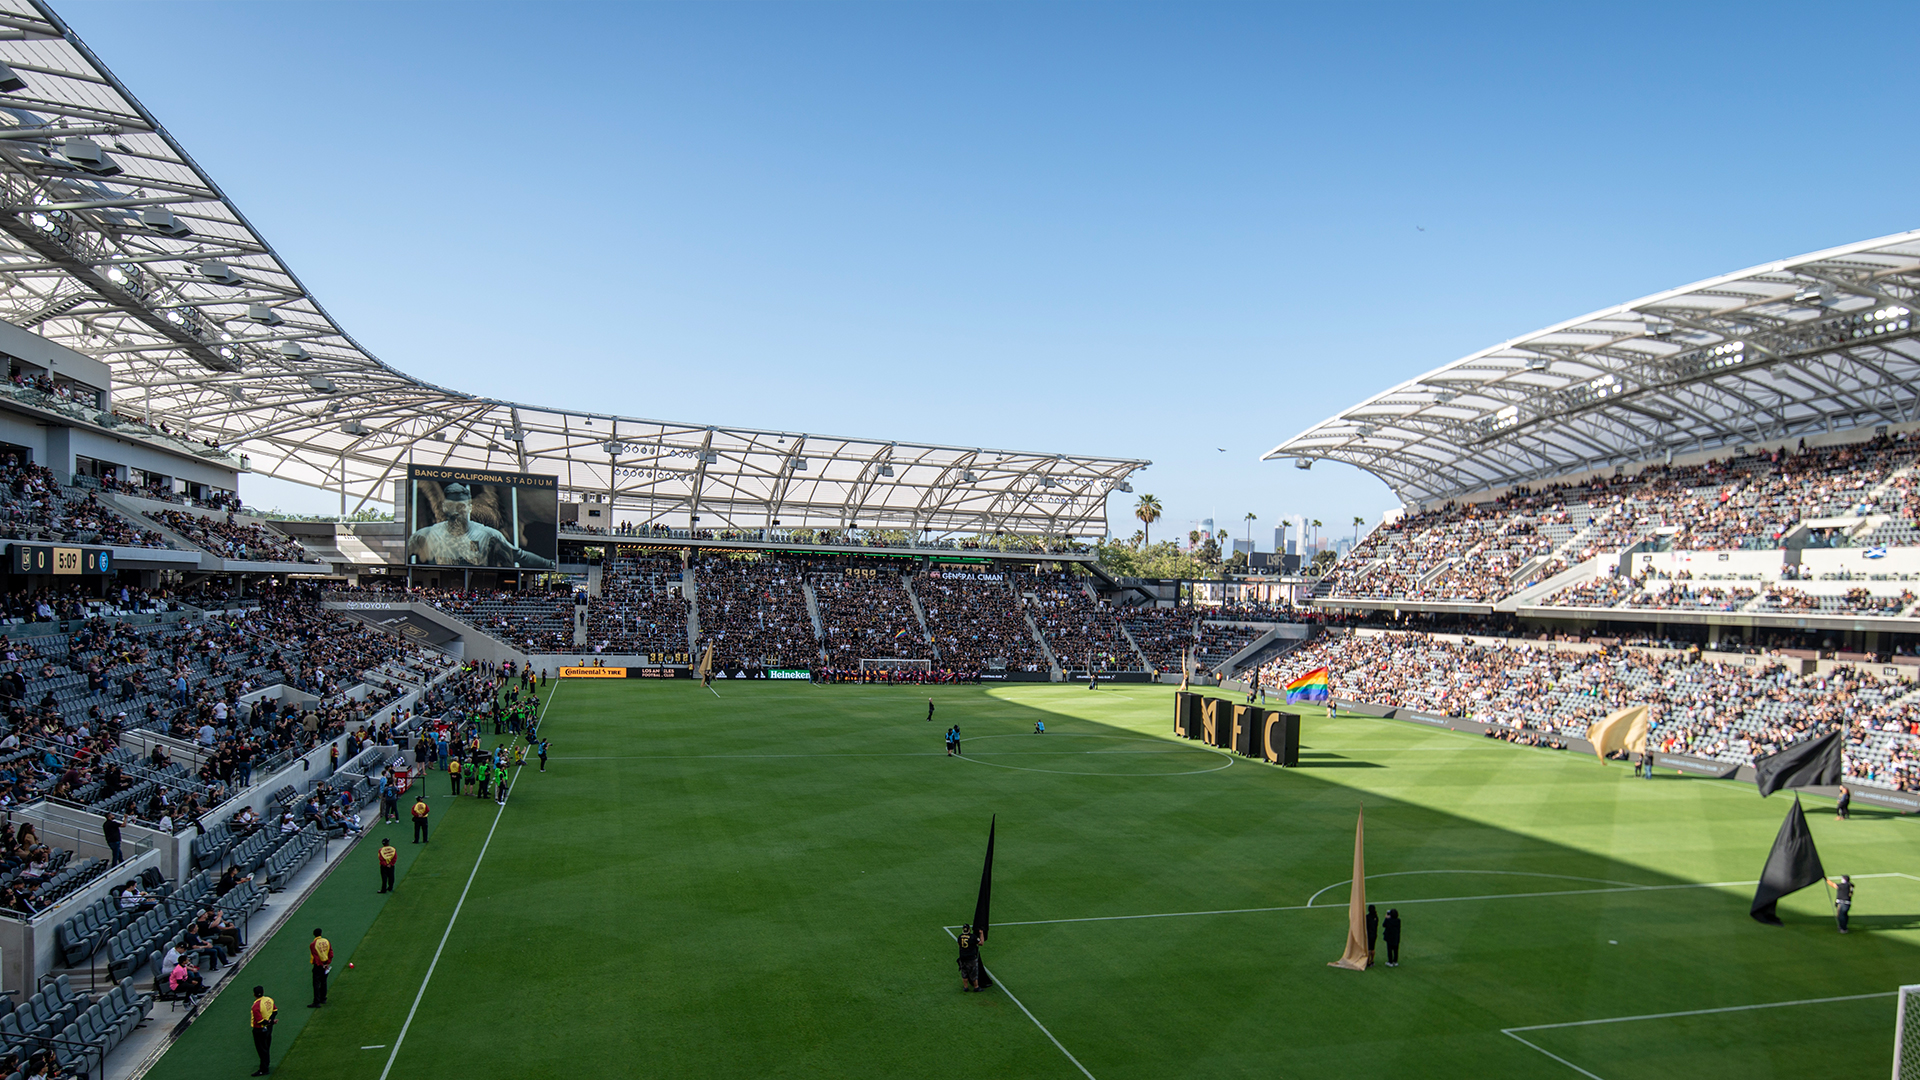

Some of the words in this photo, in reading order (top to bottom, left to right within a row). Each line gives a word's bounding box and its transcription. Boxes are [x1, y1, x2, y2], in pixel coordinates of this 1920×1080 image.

[415, 469, 439, 478] BANC
[441, 471, 452, 479] OF
[454, 472, 503, 483] CALIFORNIA
[505, 476, 553, 487] STADIUM
[38, 551, 45, 569] 0
[59, 552, 77, 569] 5:09
[89, 553, 95, 570] 0
[977, 573, 1003, 582] CIMAN
[360, 602, 391, 610] TOYOTA
[565, 668, 601, 676] Continental
[770, 670, 811, 680] Heineken
[960, 937, 969, 949] 15
